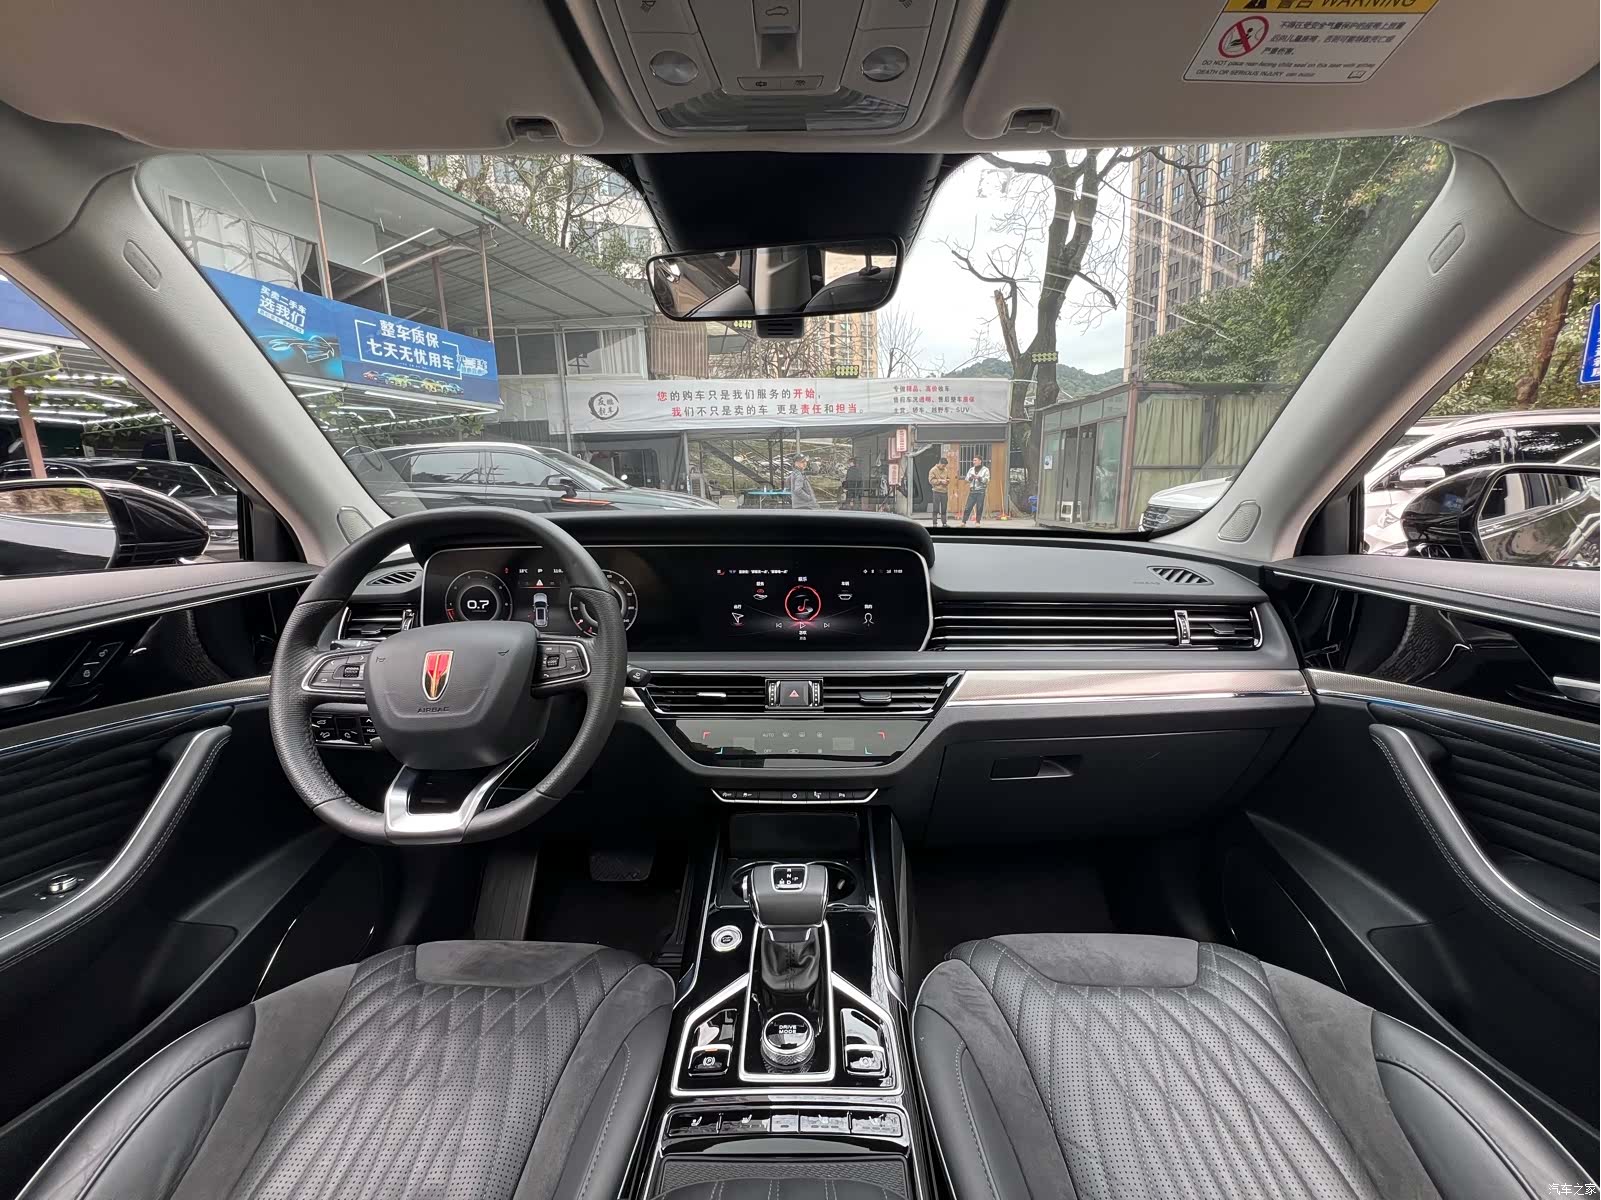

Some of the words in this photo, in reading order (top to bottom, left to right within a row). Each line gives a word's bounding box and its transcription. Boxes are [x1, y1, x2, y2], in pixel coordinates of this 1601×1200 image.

[259, 298, 305, 327] 选我们
[260, 285, 307, 315] 买卖二手车
[379, 319, 440, 349] 整车质保
[366, 338, 455, 371] 七天无忧用车
[671, 404, 769, 417] 我们不只是卖的车
[467, 599, 490, 609] 0.7
